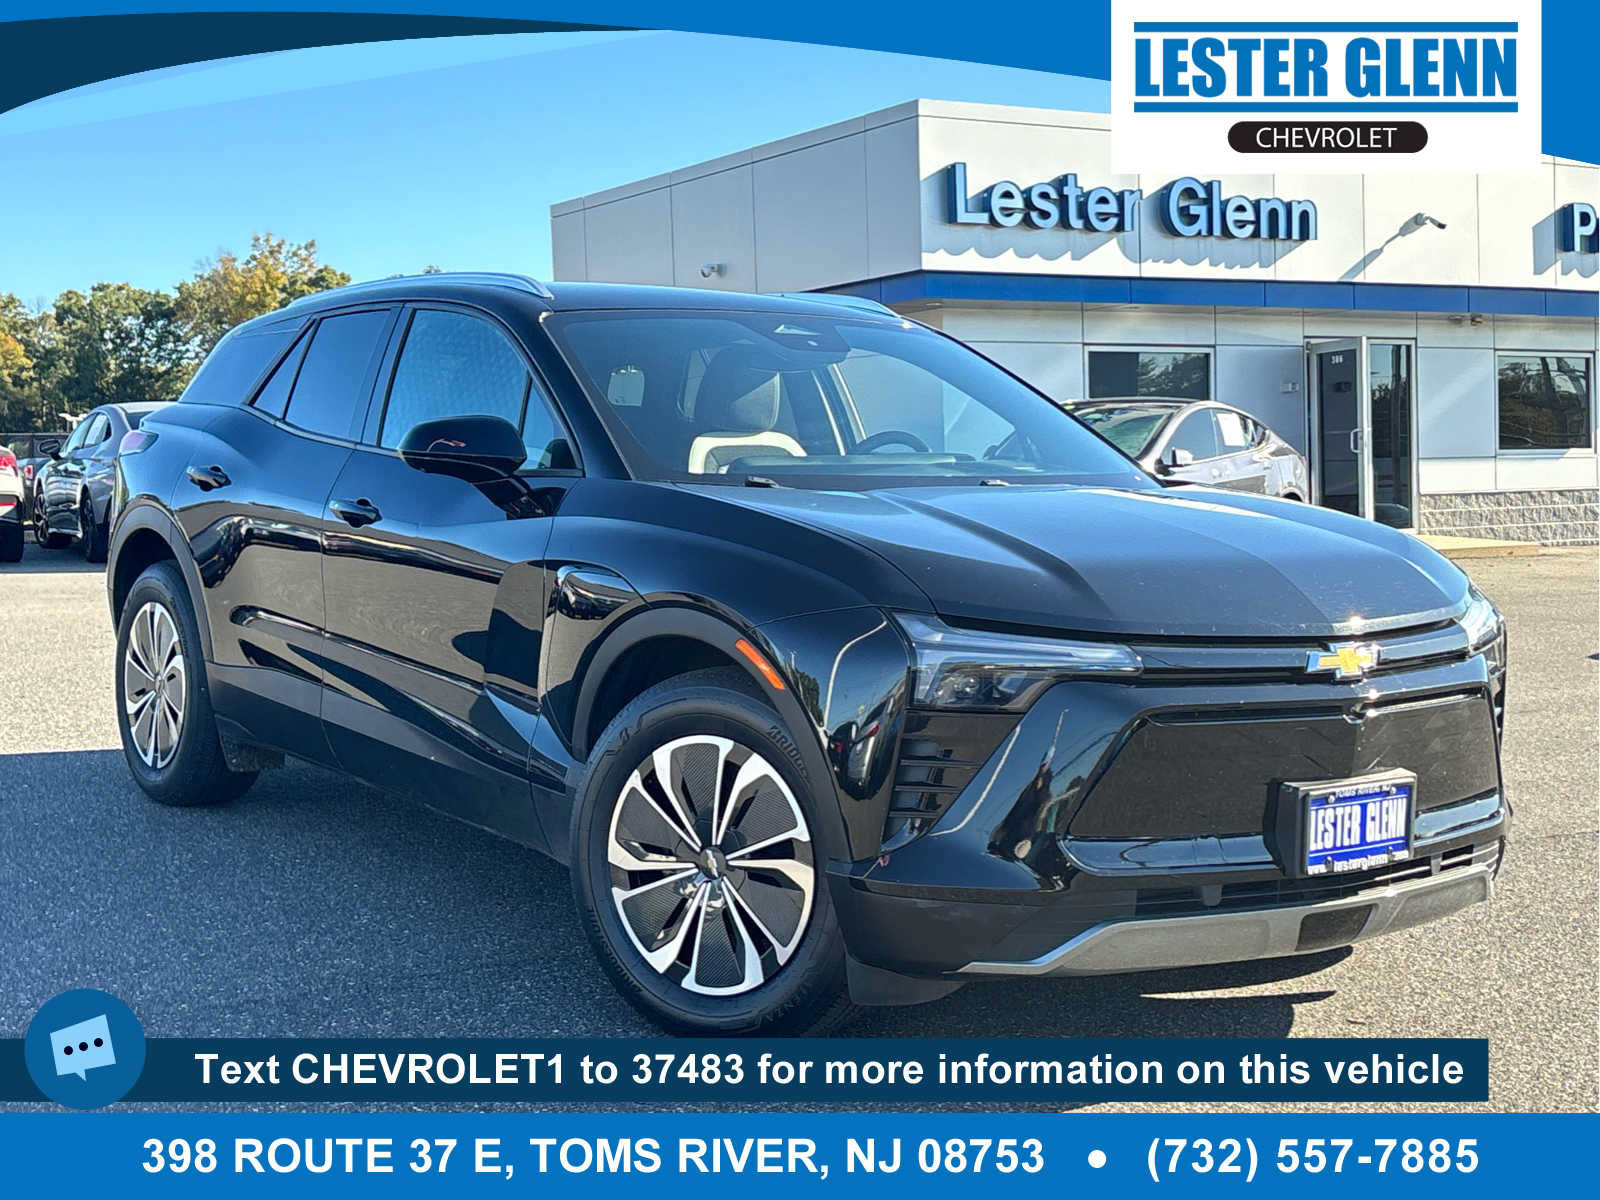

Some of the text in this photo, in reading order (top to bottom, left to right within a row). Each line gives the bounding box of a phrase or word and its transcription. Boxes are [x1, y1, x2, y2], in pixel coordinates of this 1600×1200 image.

[952, 163, 1317, 240] Lester Glenn
[1310, 797, 1407, 851] LESTER GLENN
